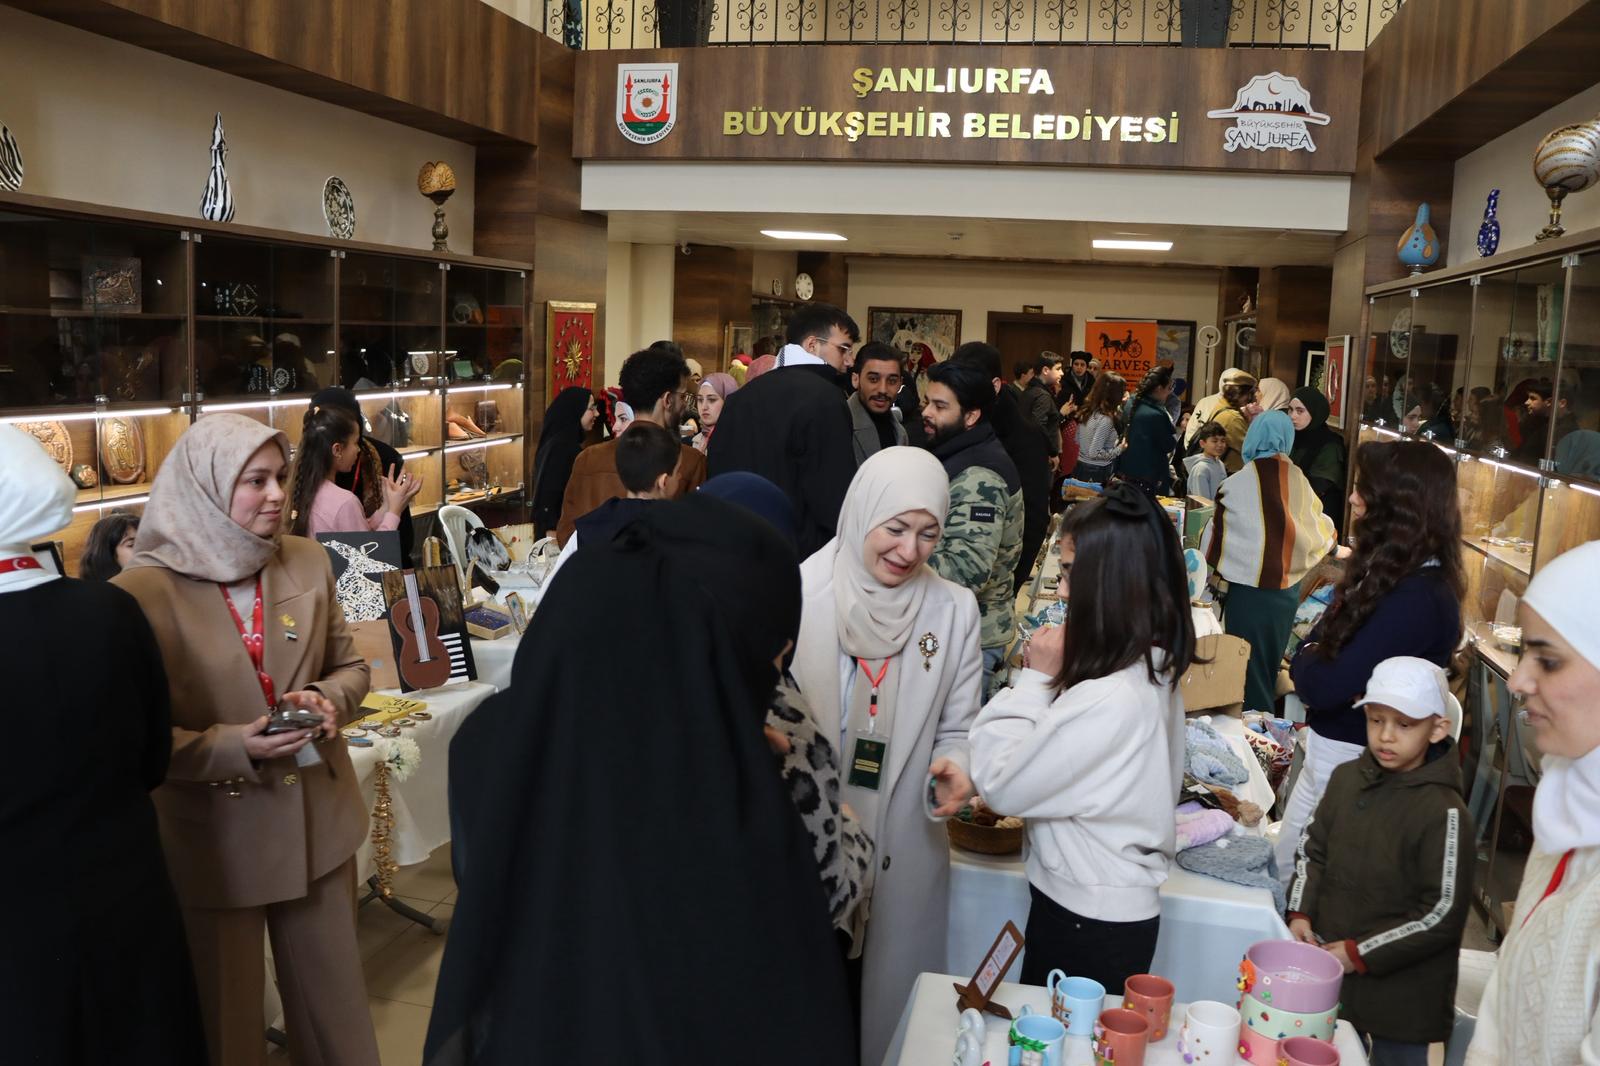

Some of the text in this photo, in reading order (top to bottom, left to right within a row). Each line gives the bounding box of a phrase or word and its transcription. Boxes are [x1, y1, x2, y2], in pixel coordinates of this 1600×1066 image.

[852, 67, 1055, 98] ŞANLIURFA
[723, 106, 1180, 144] BÜYÜKŞEHİR BELEDİYESİ
[1227, 129, 1313, 149] ŞANLIURFA
[1098, 359, 1151, 372] ARVES
